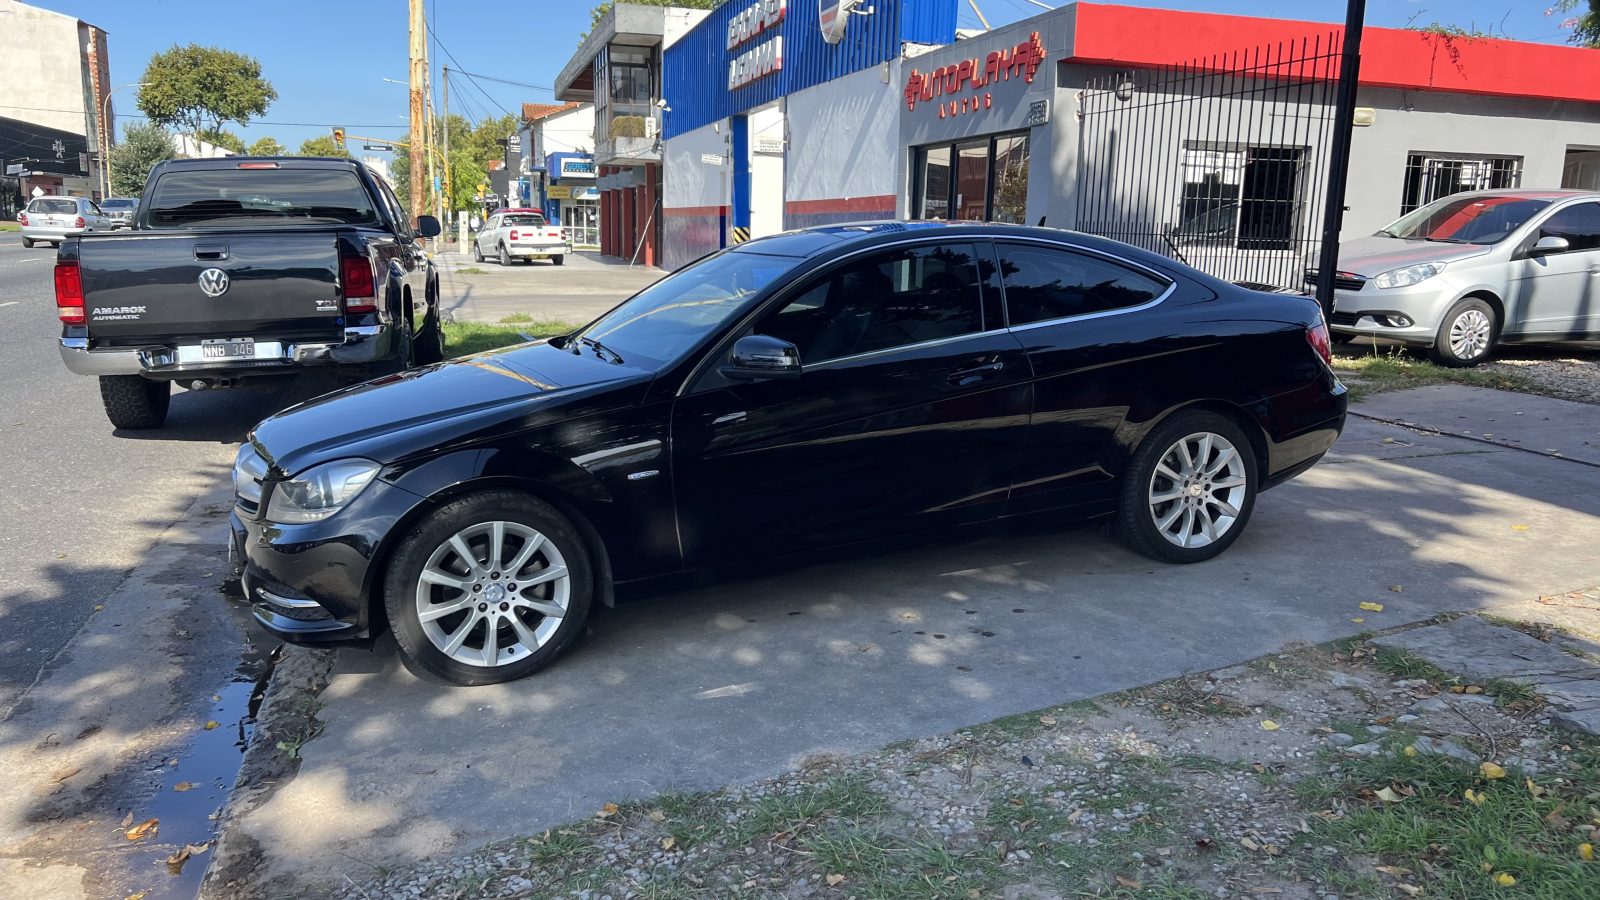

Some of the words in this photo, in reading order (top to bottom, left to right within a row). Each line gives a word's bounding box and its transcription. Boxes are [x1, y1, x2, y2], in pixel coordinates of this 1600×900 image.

[939, 92, 991, 118] AUTOS
[92, 306, 147, 315] AMAROK
[203, 344, 225, 357] NNB
[232, 343, 253, 356] 346
